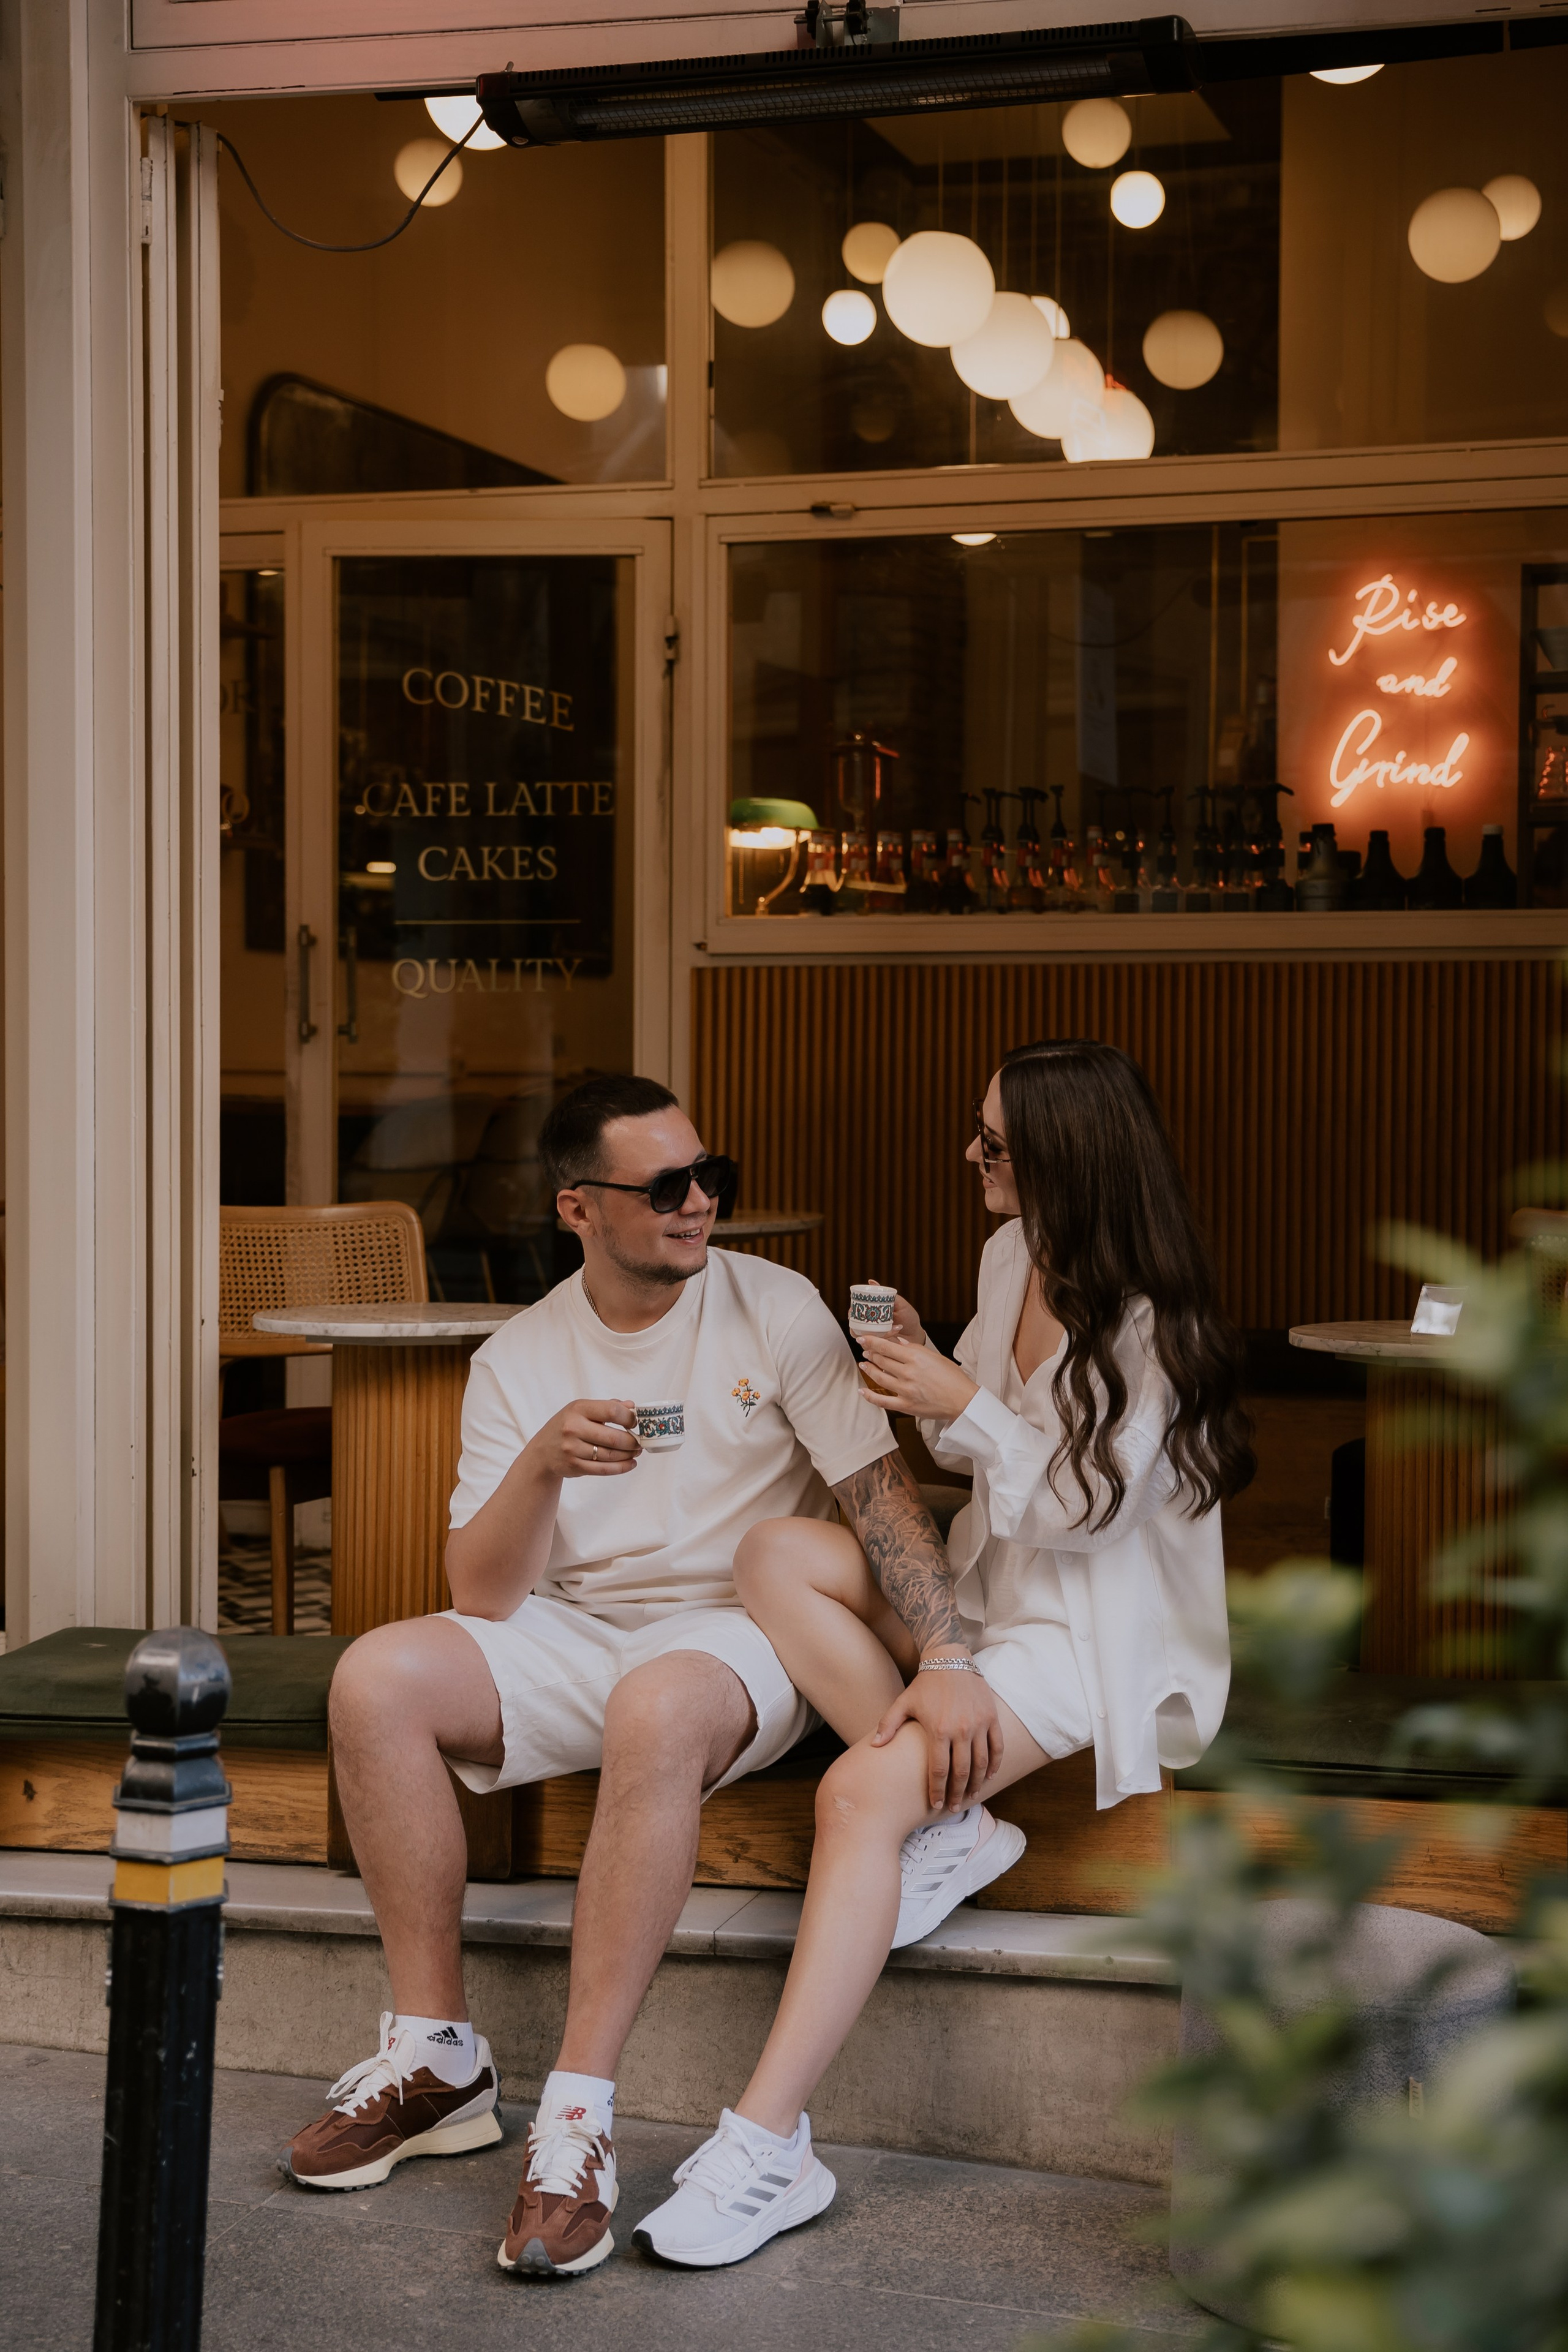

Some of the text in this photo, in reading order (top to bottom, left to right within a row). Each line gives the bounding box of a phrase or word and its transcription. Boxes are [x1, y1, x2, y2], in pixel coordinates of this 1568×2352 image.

[1329, 574, 1467, 666] Rise
[1376, 656, 1458, 698] and
[402, 667, 575, 732] COFFEE
[1330, 709, 1470, 808] Grind
[362, 782, 614, 817] CAFE LATTE
[418, 846, 558, 881] CAKES
[391, 958, 583, 999] QUALITY
[427, 2035, 464, 2046] adidas
